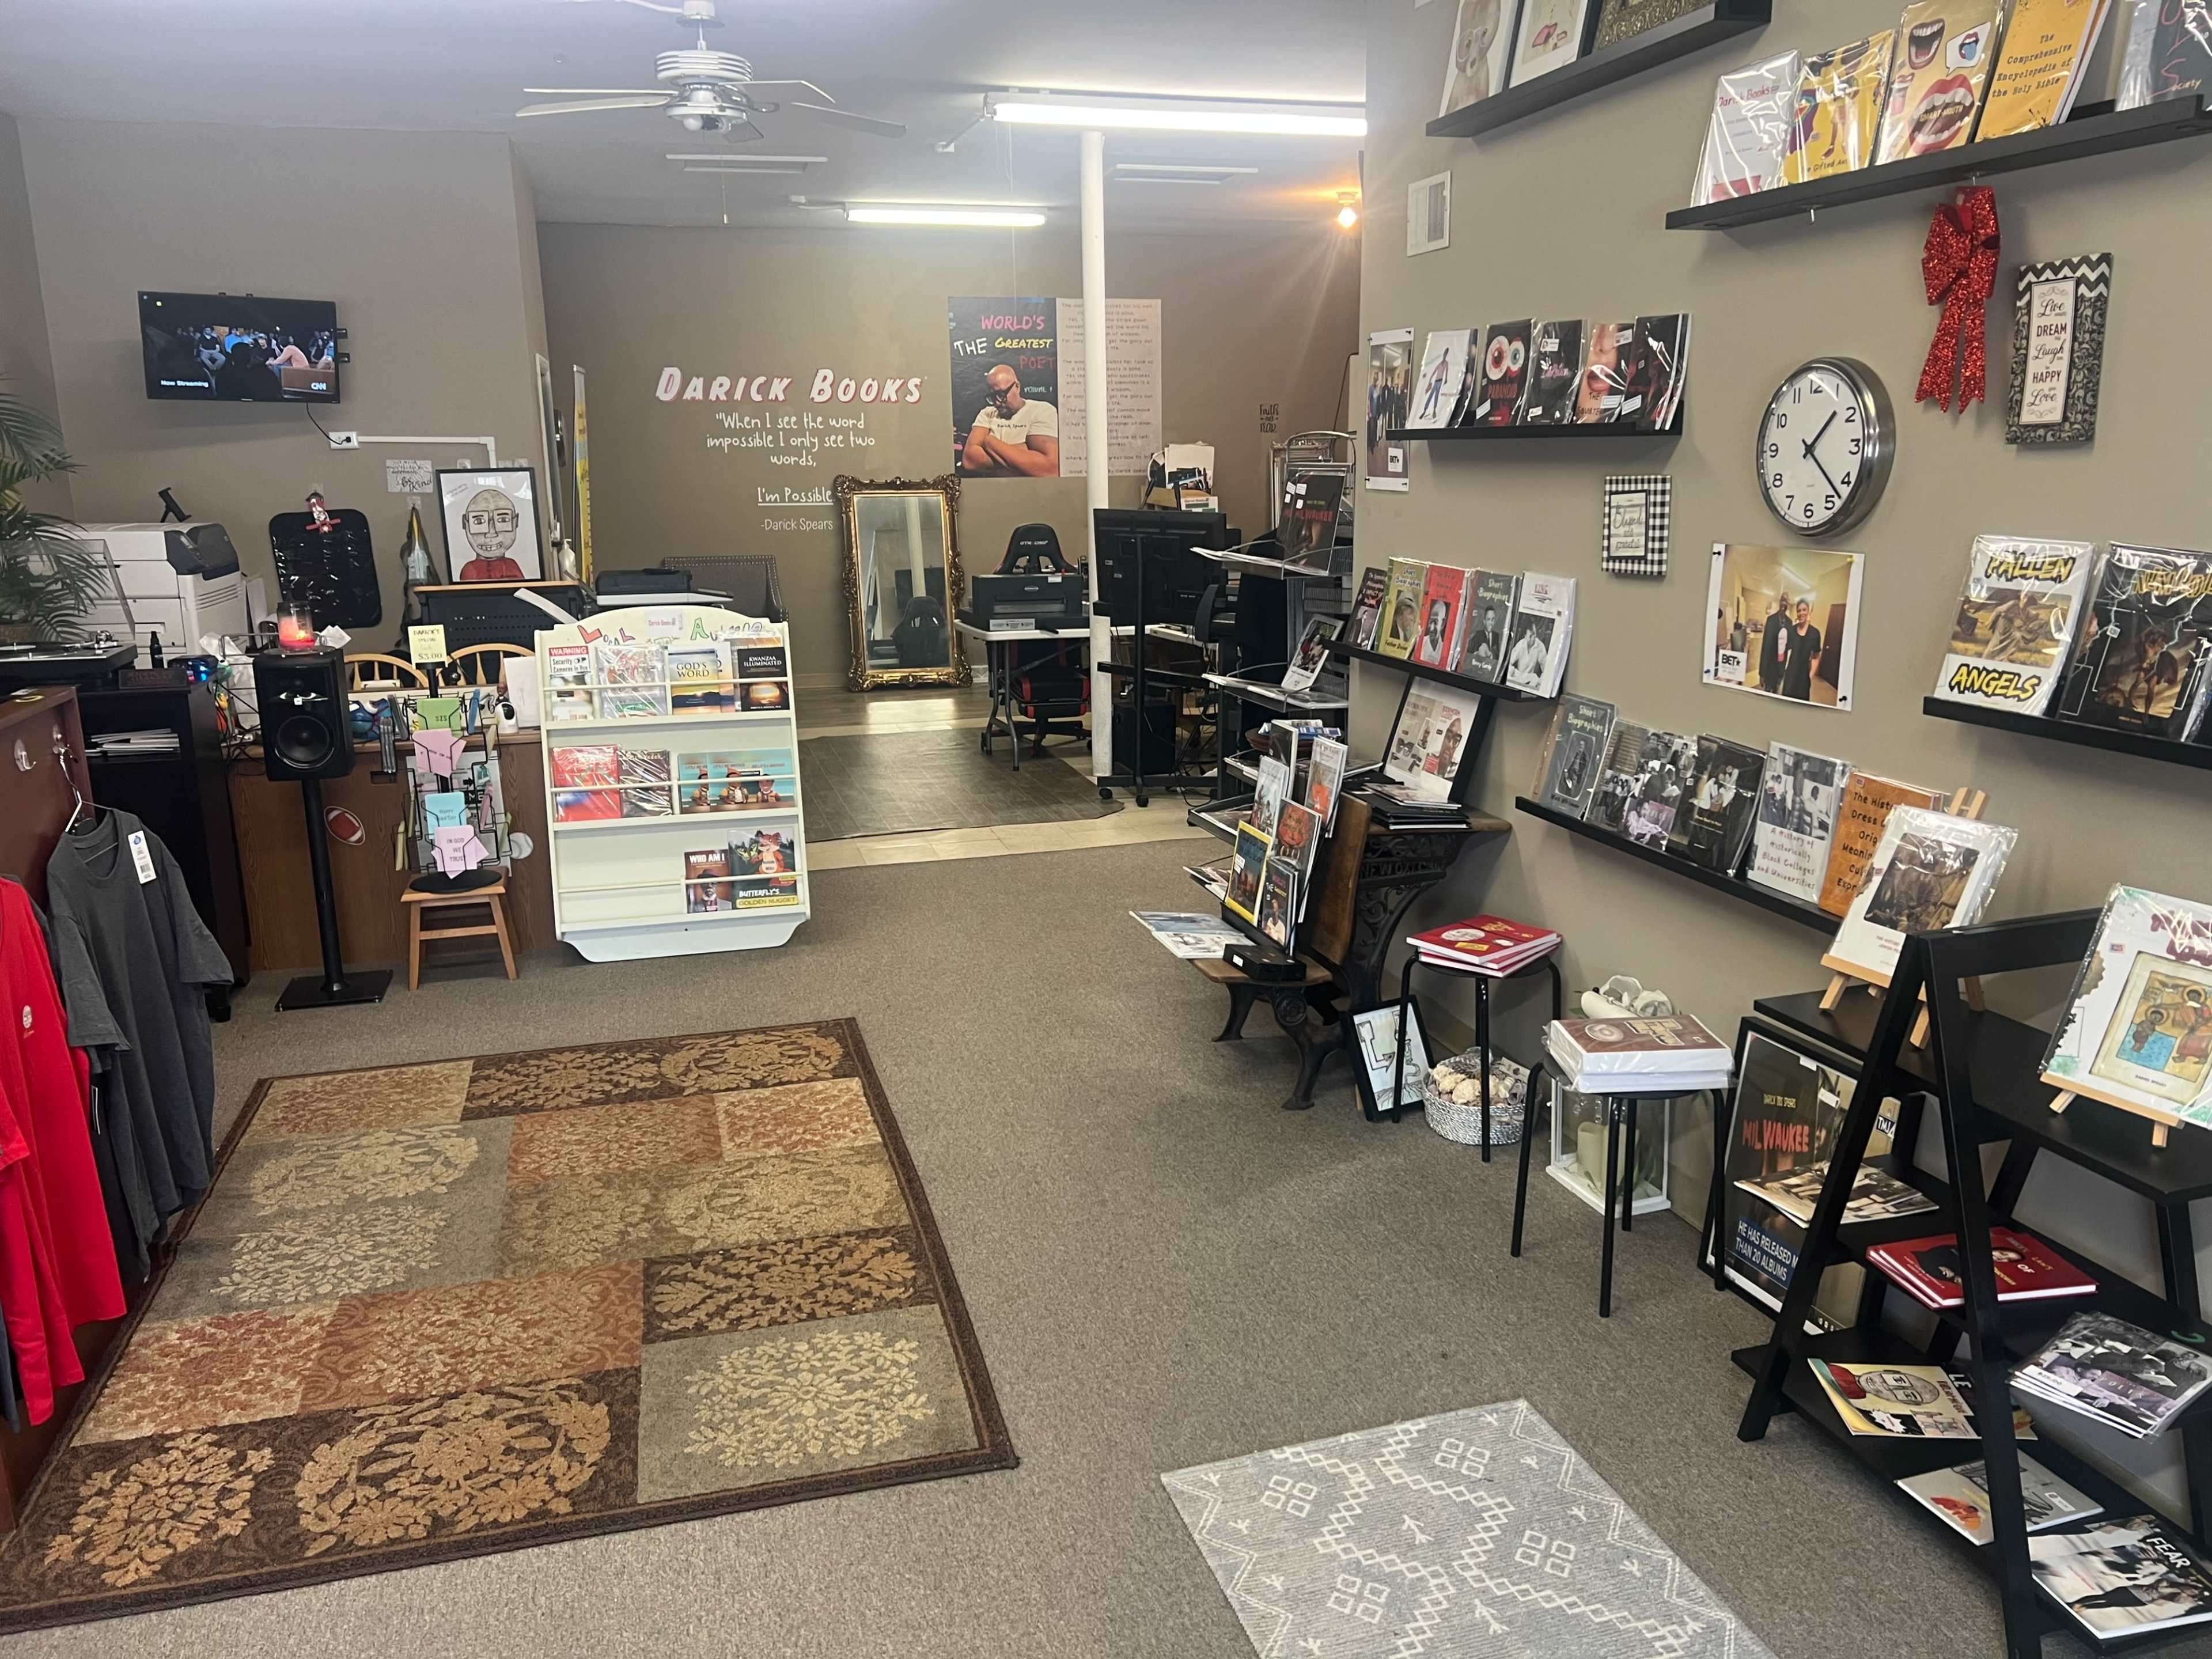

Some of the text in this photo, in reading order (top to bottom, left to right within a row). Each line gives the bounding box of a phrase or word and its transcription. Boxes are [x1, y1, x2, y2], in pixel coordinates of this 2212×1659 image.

[2040, 34, 2054, 44] The
[2008, 44, 2072, 65] Comprehensive
[1997, 57, 2072, 81] Encyclopedia of
[1747, 85, 1770, 101] Books
[1992, 77, 2061, 97] the Holy Bible
[2037, 298, 2065, 317] Live
[981, 315, 1046, 331] WORLD'S
[2036, 323, 2067, 337] DREAM
[954, 336, 1053, 357] THE GREATEST
[2032, 338, 2067, 364] Laugh
[1020, 355, 1055, 369] POET
[656, 367, 923, 403] DARICK BOOKS
[2032, 370, 2062, 384] HAPPY
[311, 382, 327, 391] CNN
[1810, 379, 1824, 395] 12
[1793, 387, 1857, 423] 11 2
[716, 412, 865, 429] "When I see the word
[707, 432, 875, 453] impossible I only see two
[1777, 413, 1861, 455] 10 3
[770, 450, 817, 467] words,
[1768, 443, 1852, 487] 9 4
[757, 487, 780, 503] I'm
[1772, 473, 1836, 510] 8 5
[1786, 495, 1814, 518] 7 6
[761, 517, 834, 533] -Darick Spears
[1984, 550, 2077, 584] FALLEN
[551, 646, 587, 656] WARNING
[552, 657, 572, 665] Security
[676, 662, 707, 670] GOD'S
[1721, 654, 1738, 666] BET
[677, 669, 710, 678] WORD
[1949, 662, 2042, 702] ANGELS
[1579, 704, 1596, 718] Short
[1567, 713, 1604, 733] Biographies
[1853, 791, 1868, 804] The
[1851, 809, 1877, 825] Dress
[1770, 840, 1811, 863] Historically
[1807, 839, 1815, 849] of
[689, 853, 725, 864] WHO AM I
[1762, 851, 1816, 876] Black Colleges
[1771, 869, 1816, 889] Universities
[738, 888, 780, 898] BUTTERFLY'S
[738, 896, 796, 906] GOLDEN NUGGET
[1743, 1119, 1809, 1153] MILWAUKEE
[1738, 1220, 1748, 1237] HE
[1747, 1226, 1761, 1245] HAS
[1760, 1234, 1791, 1265] RELEASED
[1736, 1236, 1753, 1259] THAN
[1752, 1248, 1762, 1264] 20
[1760, 1254, 1787, 1282] ALBUMS
[2146, 1536, 2191, 1570] FEAR
